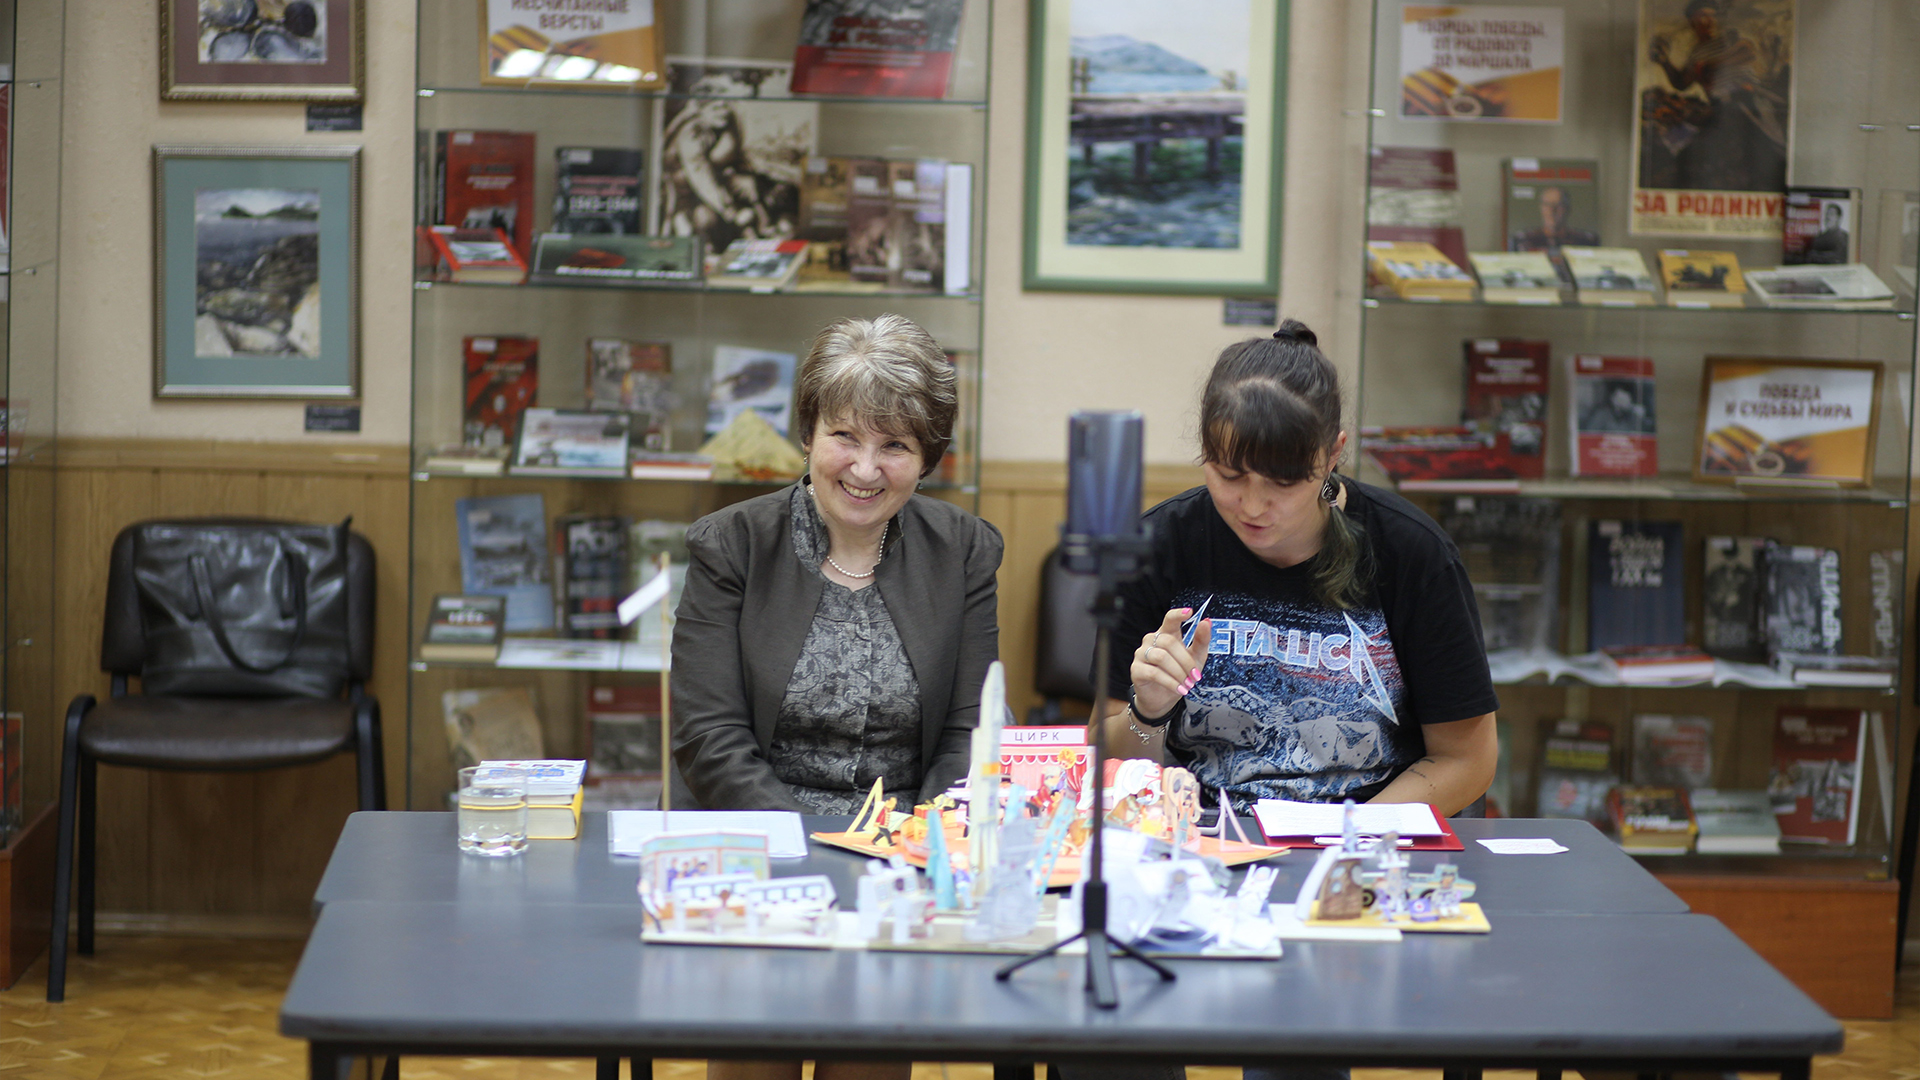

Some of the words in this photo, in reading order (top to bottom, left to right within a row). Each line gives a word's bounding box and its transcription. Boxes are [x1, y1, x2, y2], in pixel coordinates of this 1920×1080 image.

[539, 14, 604, 30] ВЕРСТЫ
[1419, 20, 1476, 34] ТВОРЦЫ
[1433, 37, 1450, 51] ОТ
[1454, 37, 1532, 52] РЯДОВОГО
[1433, 54, 1452, 68] ДО
[1456, 54, 1532, 69] МАРШАЛА
[1635, 193, 1667, 214] ЗА
[1759, 383, 1821, 400] ПОБЕДА
[1725, 401, 1736, 417] И
[1740, 401, 1803, 418] СУДЬБЫ
[1808, 403, 1853, 419] МИРА
[1015, 732, 1059, 742] ЦИРК
